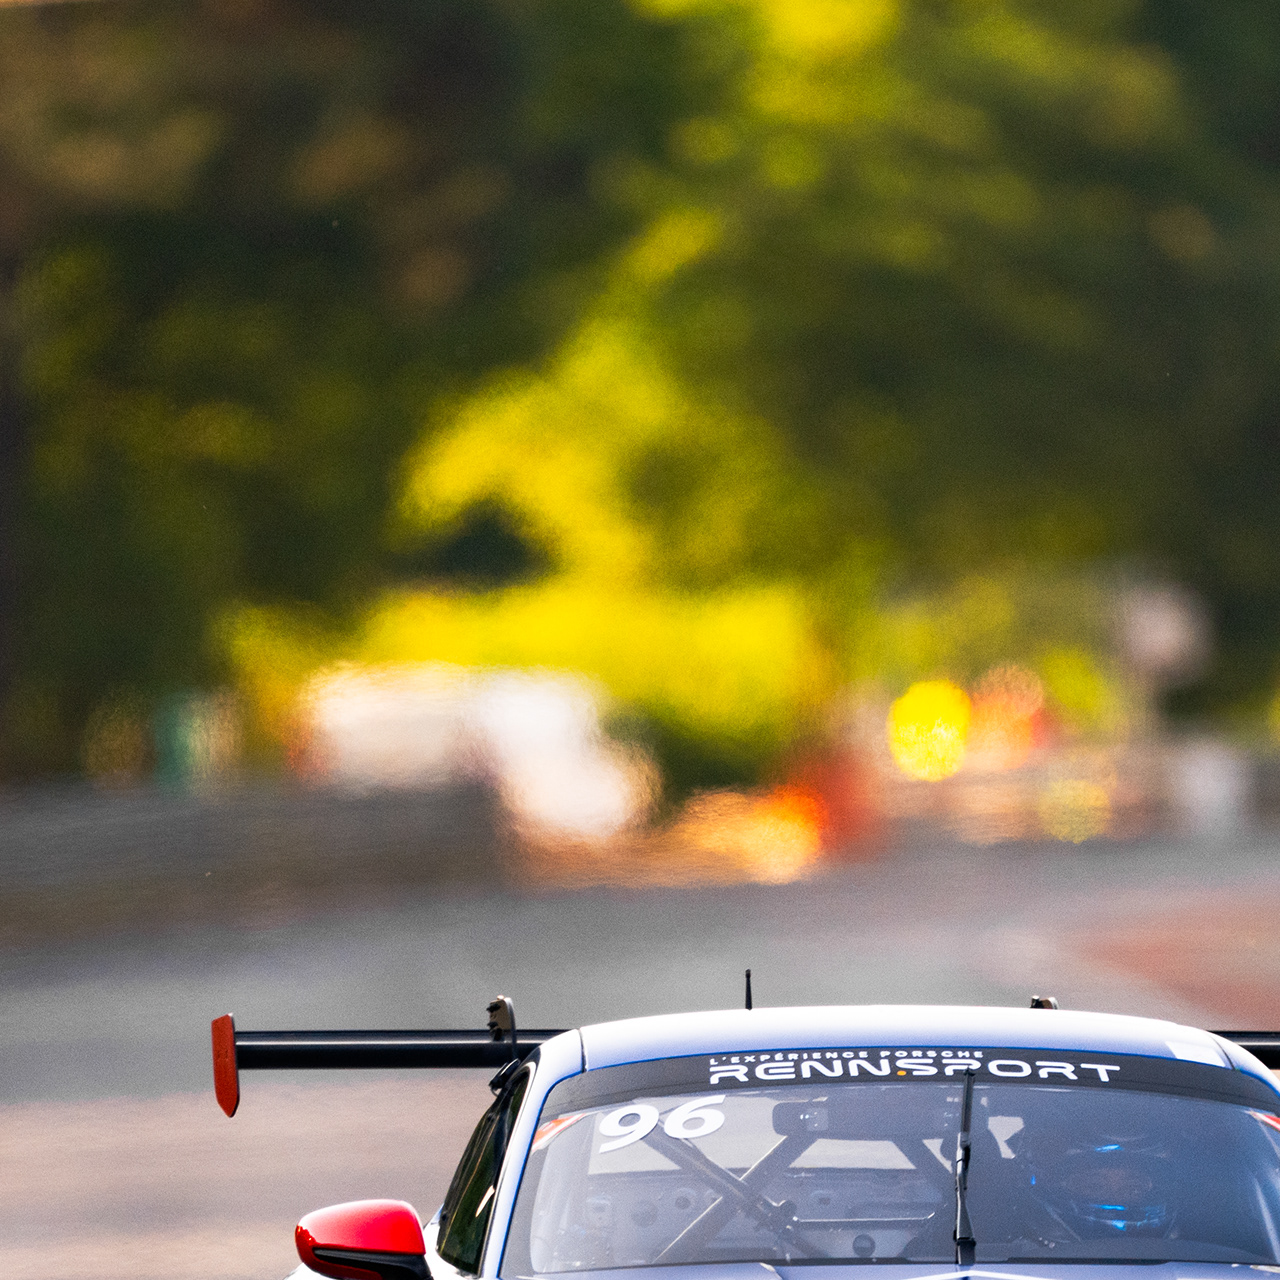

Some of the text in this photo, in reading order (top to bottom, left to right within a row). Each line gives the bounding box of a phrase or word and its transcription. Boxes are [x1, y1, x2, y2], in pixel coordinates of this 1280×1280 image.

[709, 1050, 984, 1066] L'EXPÉRIENCE PORSCHE
[598, 1094, 726, 1154] 96
